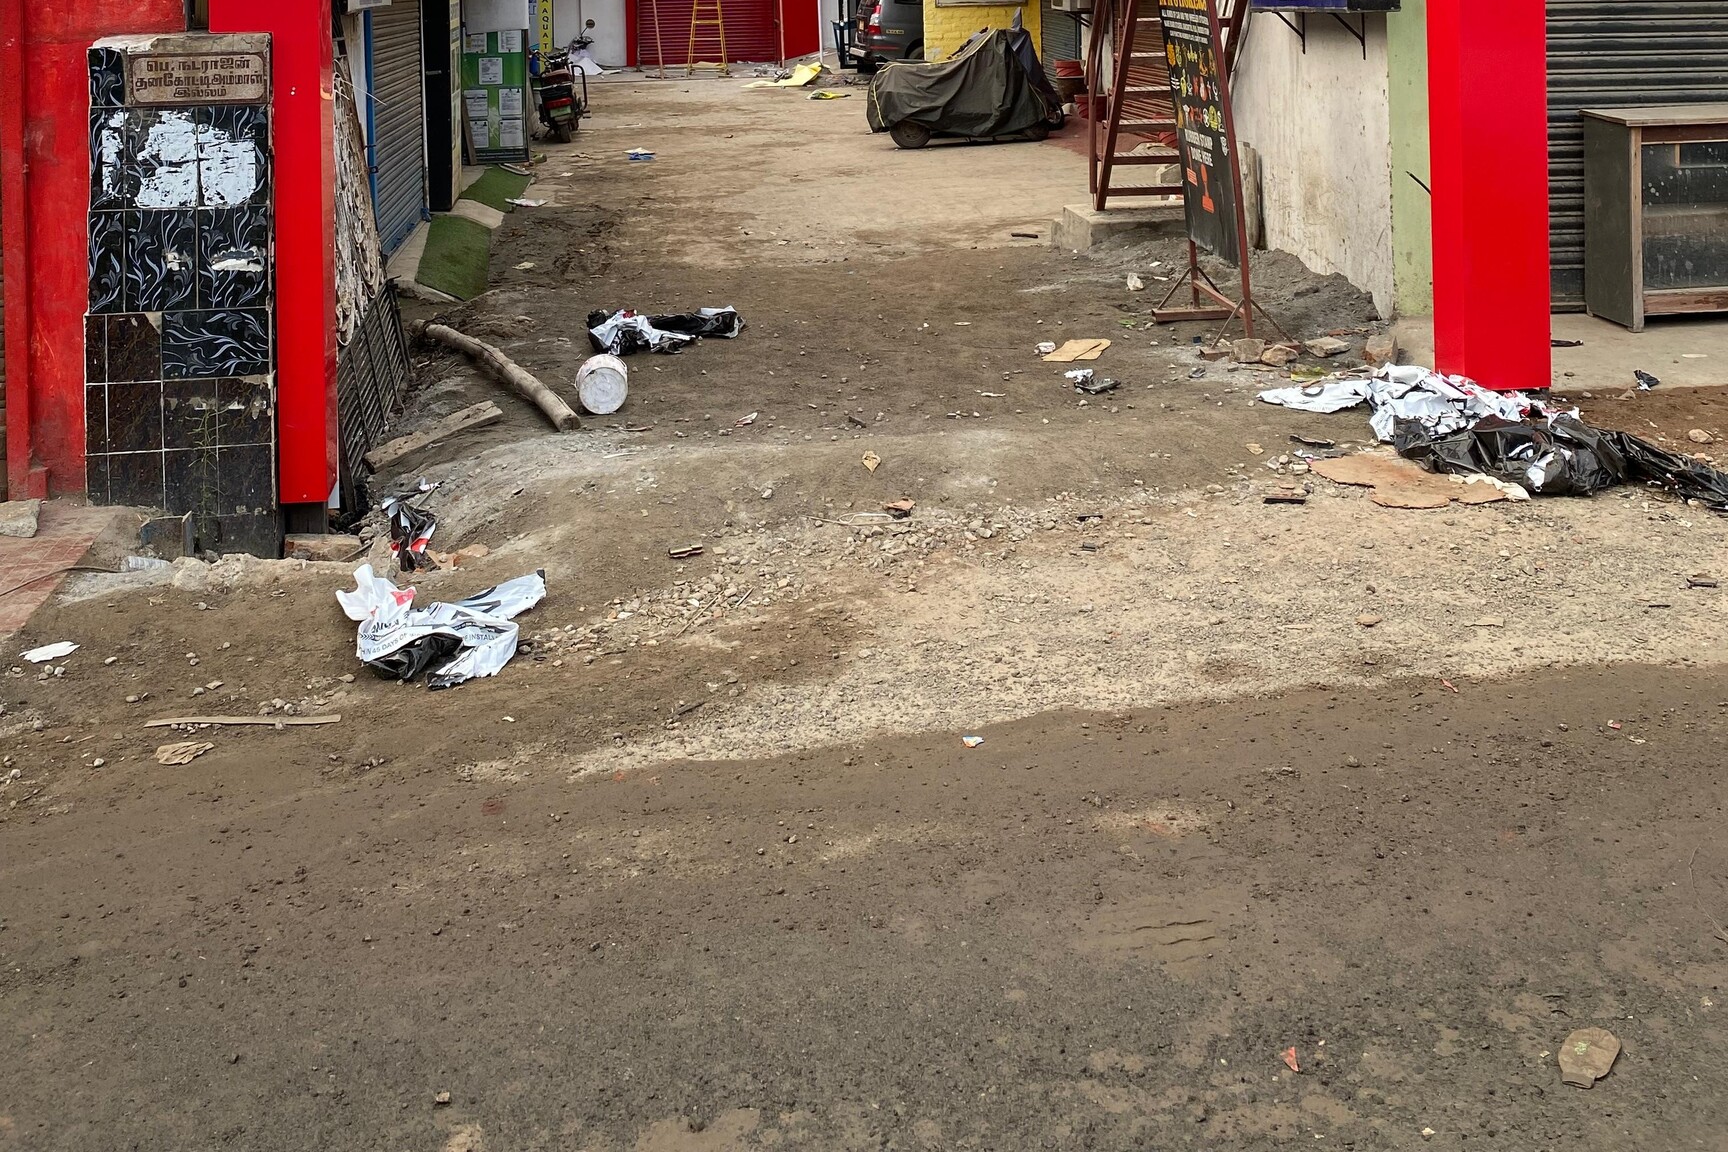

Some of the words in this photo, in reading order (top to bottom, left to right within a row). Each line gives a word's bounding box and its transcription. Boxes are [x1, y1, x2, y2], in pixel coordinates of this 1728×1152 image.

[541, 8, 549, 38] AQUA
[179, 57, 251, 74] நடராஜன்
[173, 86, 227, 98] இல்லம்
[381, 638, 399, 651] DAYS
